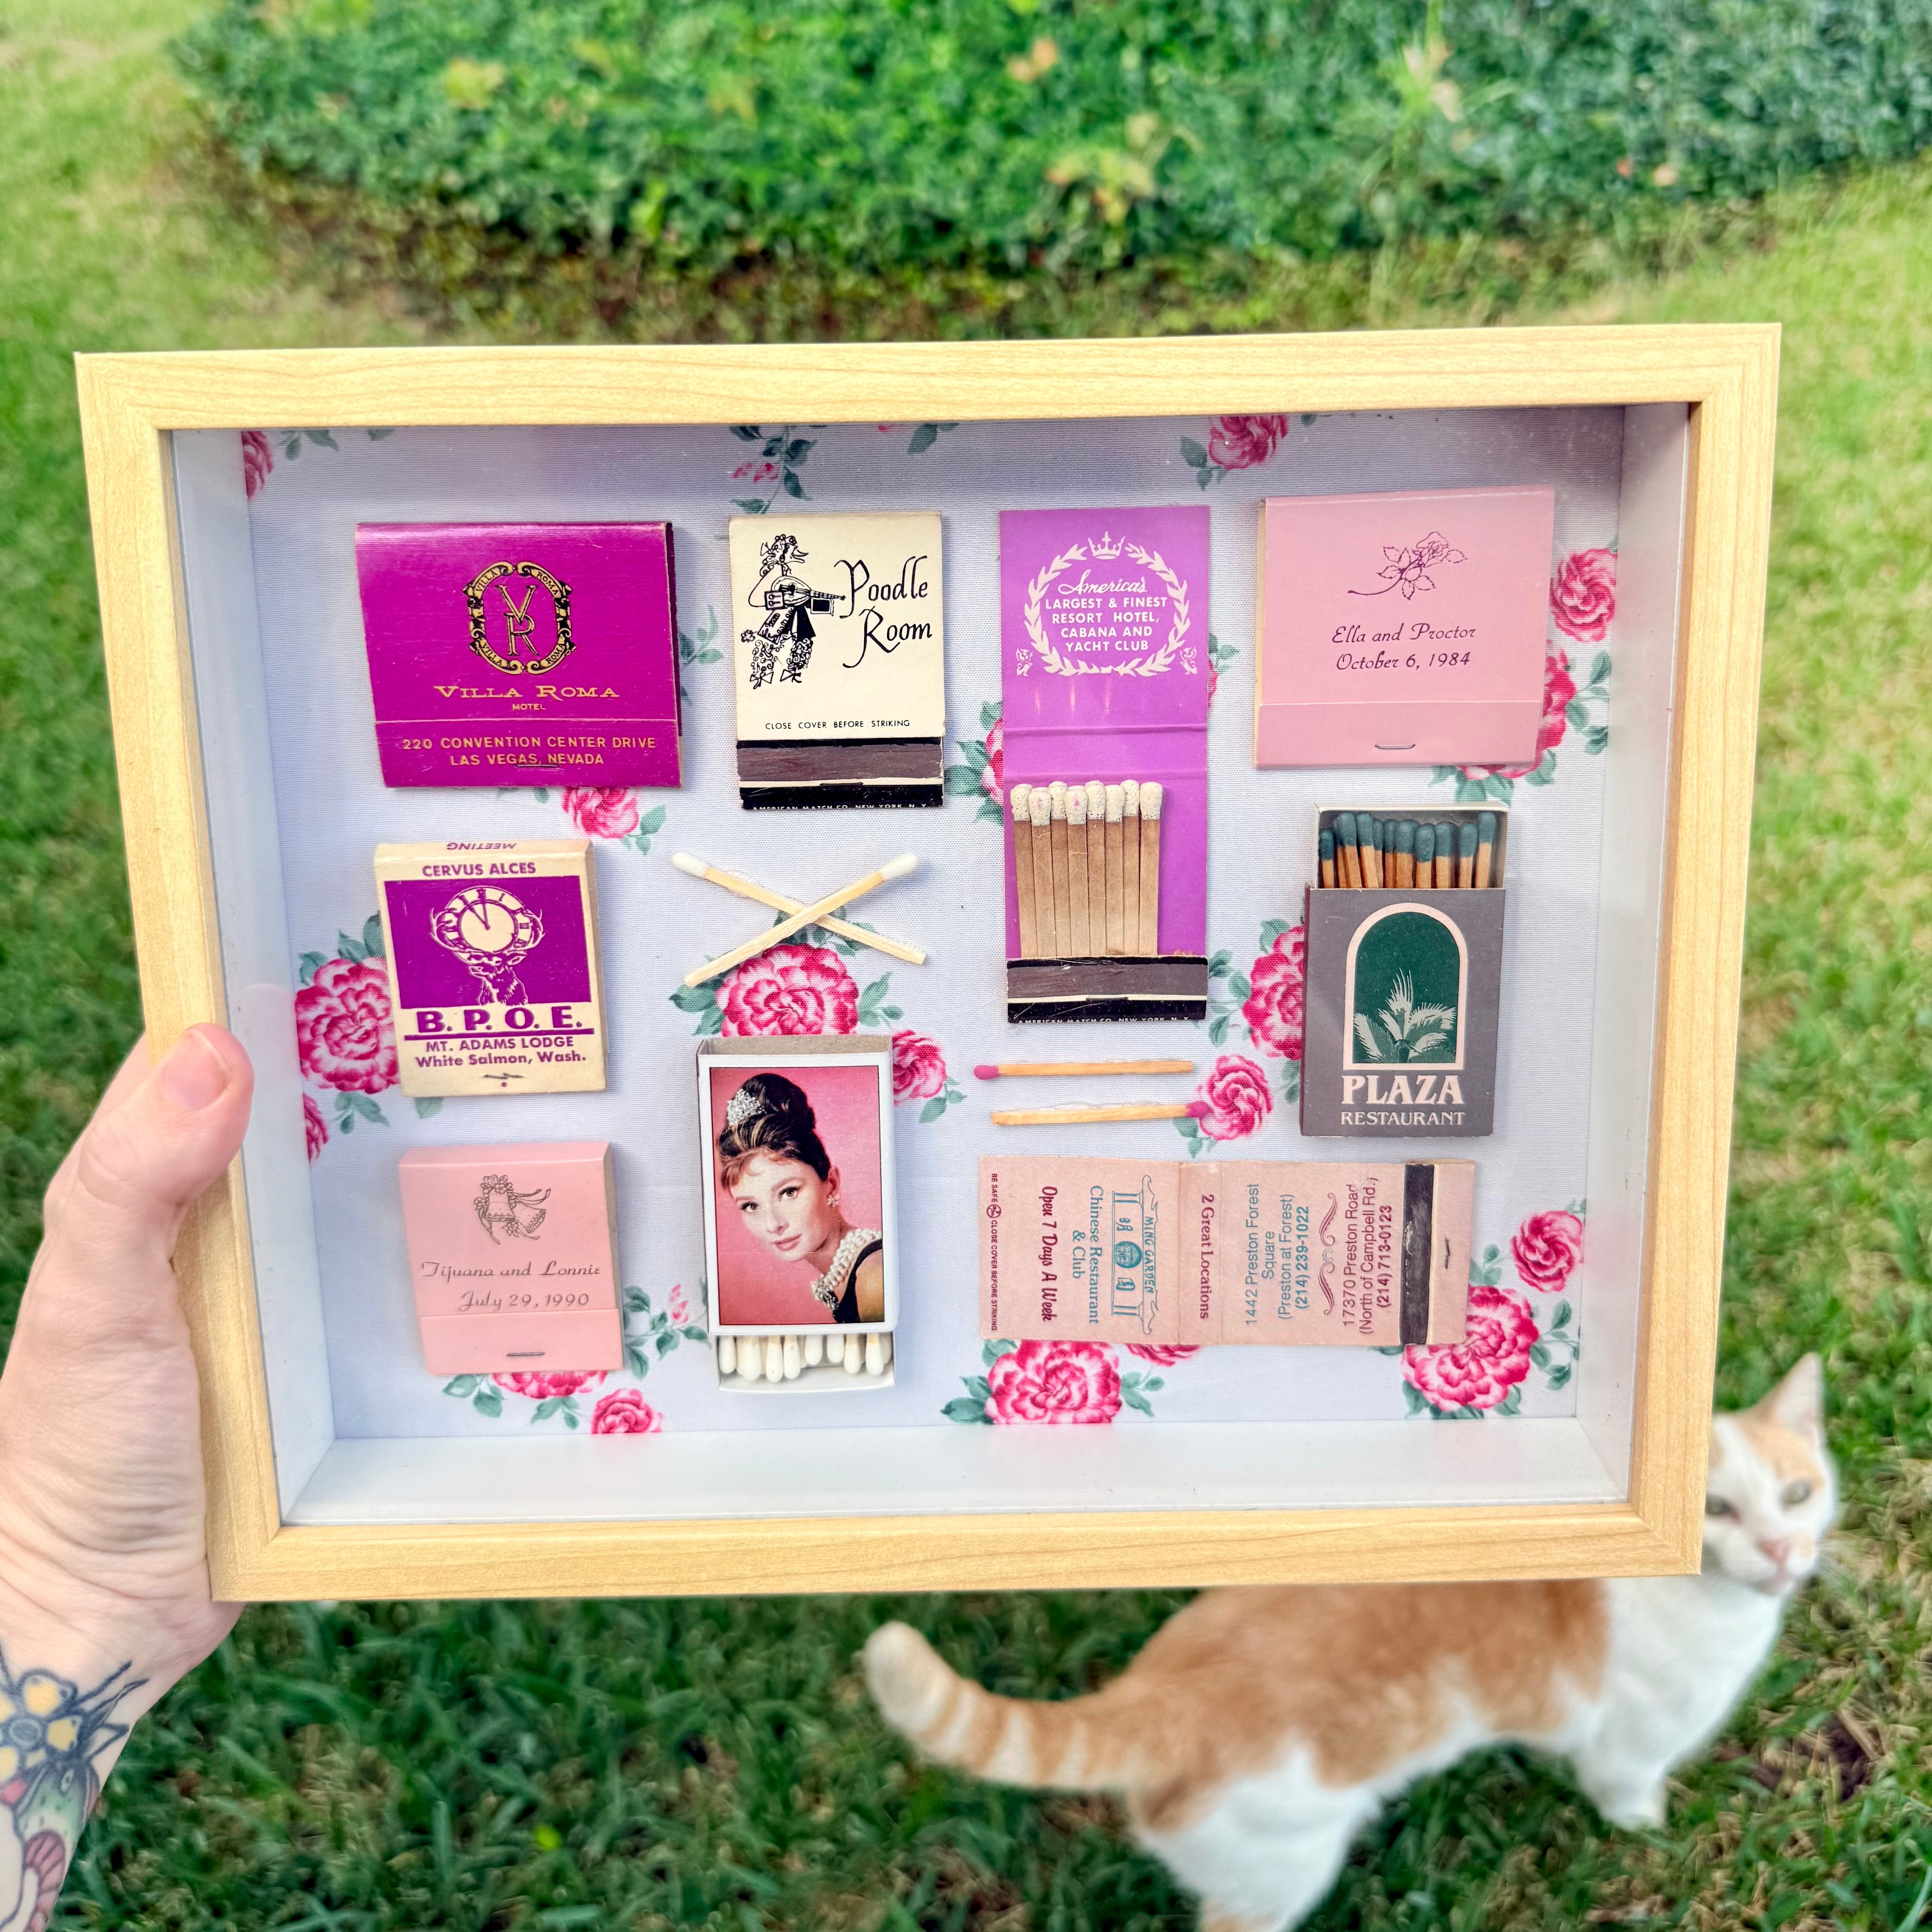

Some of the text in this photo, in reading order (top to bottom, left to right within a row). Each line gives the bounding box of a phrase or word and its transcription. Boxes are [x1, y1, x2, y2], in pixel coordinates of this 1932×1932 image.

[476, 570, 498, 592] VILLA
[537, 572, 559, 595] ROMA
[834, 555, 928, 618] Poodle
[1058, 569, 1148, 595] America's
[1045, 597, 1167, 609] LARGEST & FINEST
[1052, 611, 1159, 624] RESORT HOTEL,
[843, 606, 932, 668] Room
[1061, 626, 1152, 638] CABANA AND
[1331, 622, 1476, 643] Ella and Proctor
[482, 645, 503, 666] VILLA
[545, 643, 565, 665] ROMA
[1066, 640, 1149, 652] YACHT CLUB
[1336, 650, 1471, 670] October 6, 1984
[434, 685, 619, 701] VILLA ROMA
[403, 736, 656, 750] 220 CONVENTION CENTER DRIVE
[450, 754, 604, 766] LAS VEGAS, NEVADA
[447, 842, 517, 851] MEETING
[422, 862, 536, 876] CERVUS ALCES
[426, 1036, 574, 1052] MT. ADAMS LODGE
[415, 1051, 586, 1068] White Salmon, Wash.
[1341, 1075, 1464, 1104] PLAZA
[1341, 1111, 1465, 1125] RESTAURANT
[991, 1173, 997, 1182] BE
[1038, 1186, 1058, 1217] Open
[1038, 1233, 1058, 1266] Days
[1343, 1224, 1357, 1275] Preston
[1360, 1210, 1377, 1272] Campbell
[1072, 1231, 1085, 1279] & Club
[1089, 1186, 1103, 1324] Chinese Restaurant
[1144, 1217, 1155, 1294] MING GARDEN
[1199, 1194, 1215, 1319] 2 Great Locations
[1245, 1183, 1259, 1326] 1442 Preston Forest
[1262, 1231, 1277, 1279] Square
[1278, 1194, 1295, 1319] (Preston at Forest)
[1295, 1206, 1310, 1309] (214) 239-1022
[1377, 1205, 1393, 1308] (214) 713-0123
[422, 1260, 600, 1282] Tijuana and Lonnie
[1042, 1271, 1057, 1282] A
[1360, 1276, 1373, 1289] of
[458, 1291, 589, 1311] July 29, 1990
[1041, 1287, 1058, 1322] Week
[1342, 1279, 1355, 1326] 17370
[1359, 1293, 1374, 1334] (North
